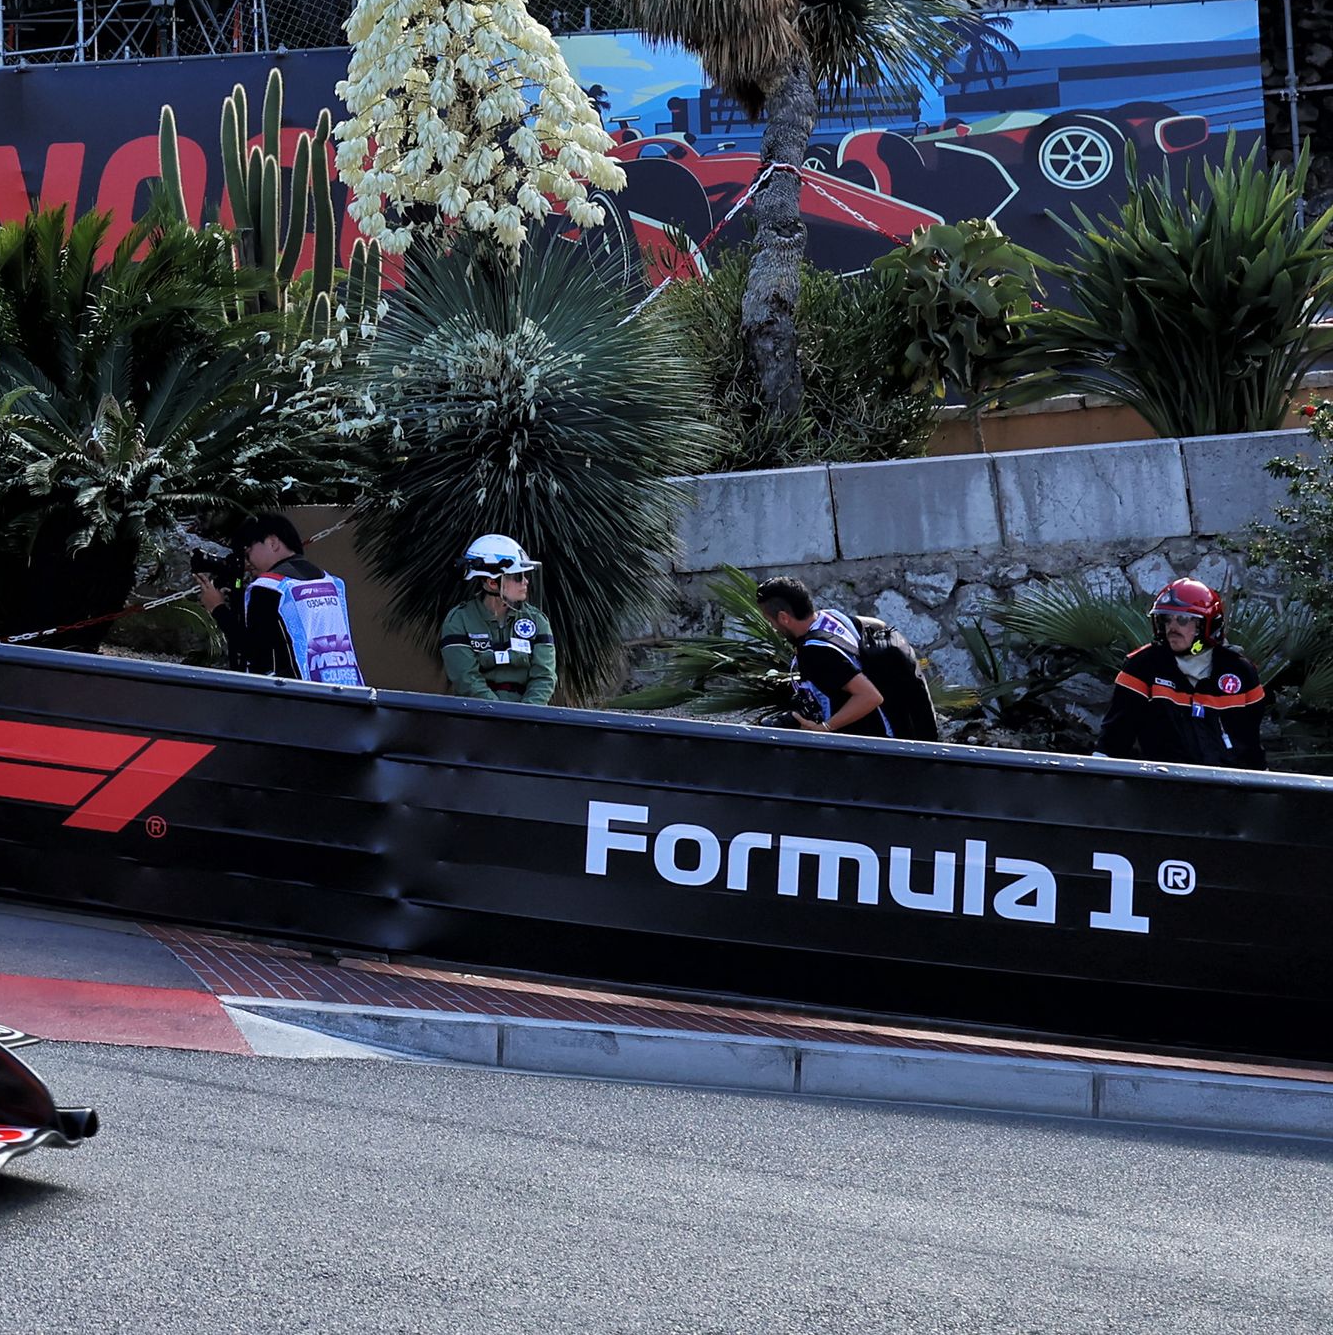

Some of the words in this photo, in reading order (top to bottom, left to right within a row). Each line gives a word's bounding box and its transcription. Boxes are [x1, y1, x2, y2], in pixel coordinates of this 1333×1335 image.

[499, 652, 505, 663] 7
[1194, 704, 1202, 716] 7
[584, 800, 1058, 925] Formula
